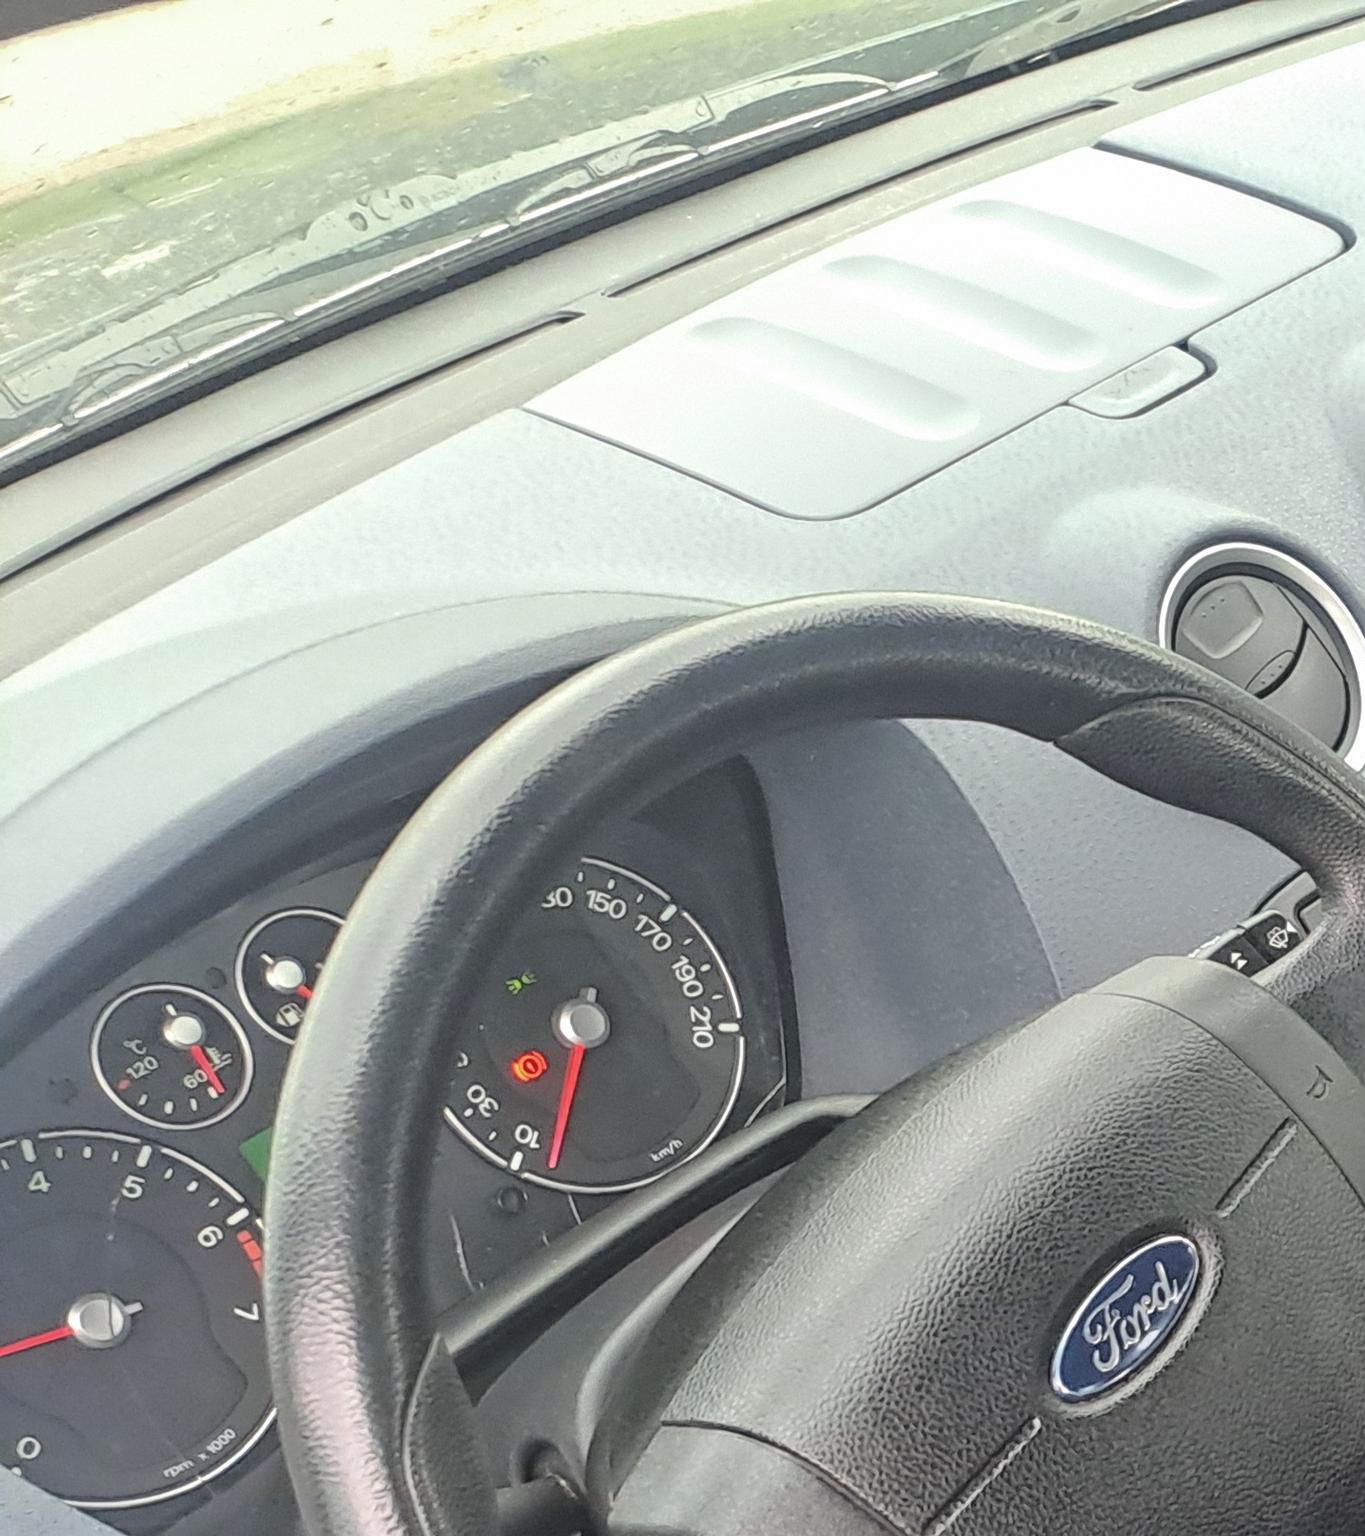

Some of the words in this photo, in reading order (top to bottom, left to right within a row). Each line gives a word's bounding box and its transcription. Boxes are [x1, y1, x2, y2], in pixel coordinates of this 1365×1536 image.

[586, 889, 627, 920] 150
[635, 914, 672, 952] 170
[671, 955, 704, 998] 190
[689, 1005, 714, 1048] 210
[126, 1056, 159, 1079] 120
[183, 1069, 209, 1088] 60
[466, 1084, 500, 1118] 30
[514, 1124, 540, 1149] 10
[650, 1138, 683, 1163] km/h
[28, 1170, 51, 1193] 4
[121, 1175, 146, 1198] 5
[197, 1225, 224, 1248] 6
[233, 1303, 260, 1320] 7
[1082, 1260, 1181, 1372] Ford
[16, 1436, 42, 1460] 0
[163, 1458, 195, 1479] rpm
[206, 1428, 237, 1456] 1000
